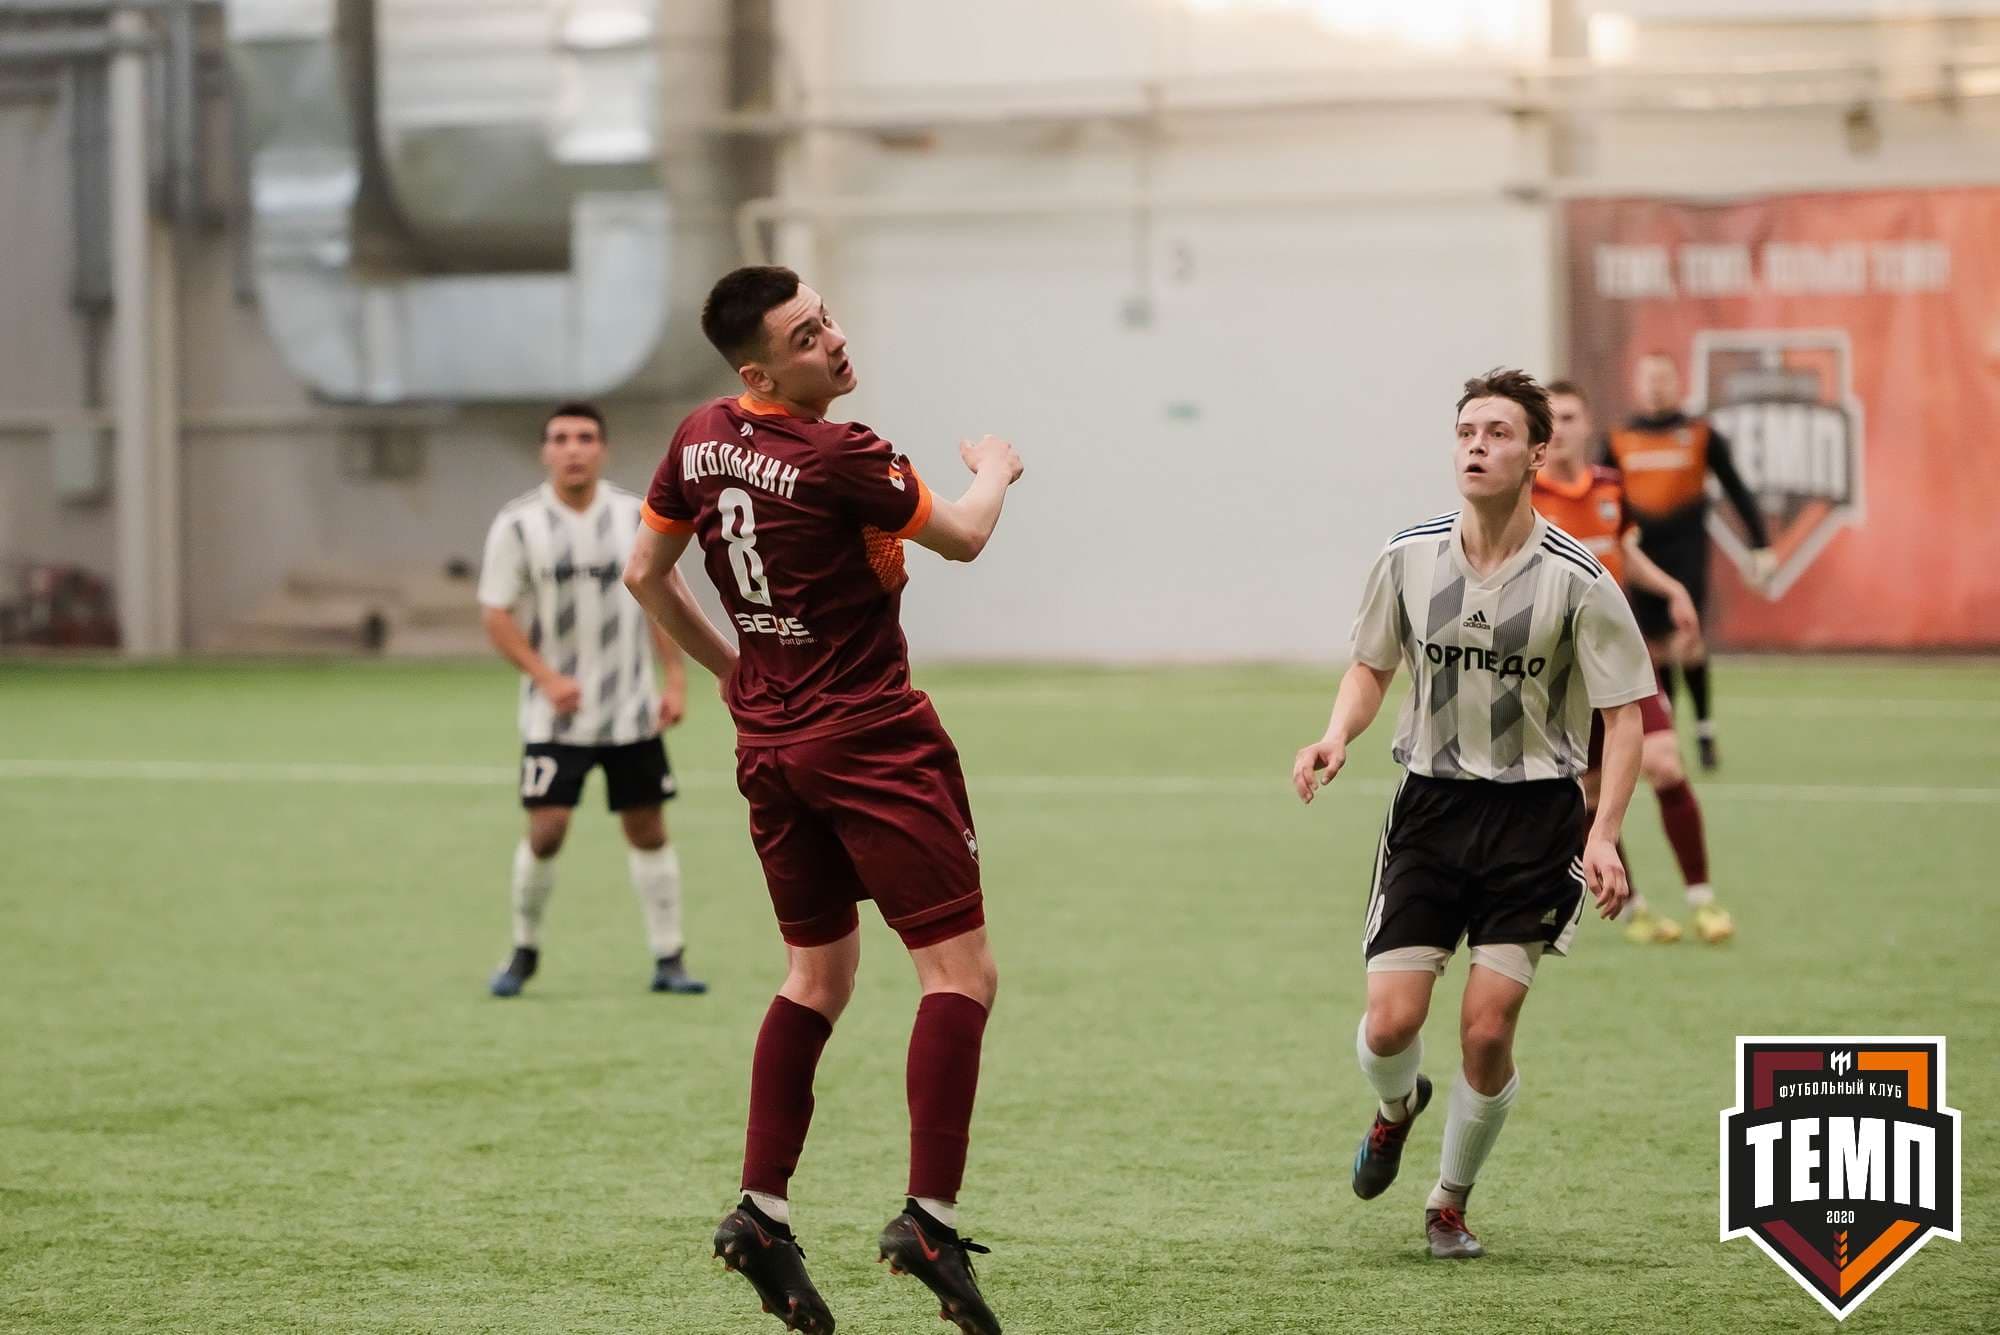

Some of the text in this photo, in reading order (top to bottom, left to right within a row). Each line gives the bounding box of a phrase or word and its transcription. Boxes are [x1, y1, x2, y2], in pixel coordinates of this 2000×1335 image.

[682, 440, 800, 500] ЩЕБЛЫКИН
[717, 487, 772, 607] 8
[1462, 620, 1491, 631] adidas
[1416, 639, 1547, 681] ОРПЕДО
